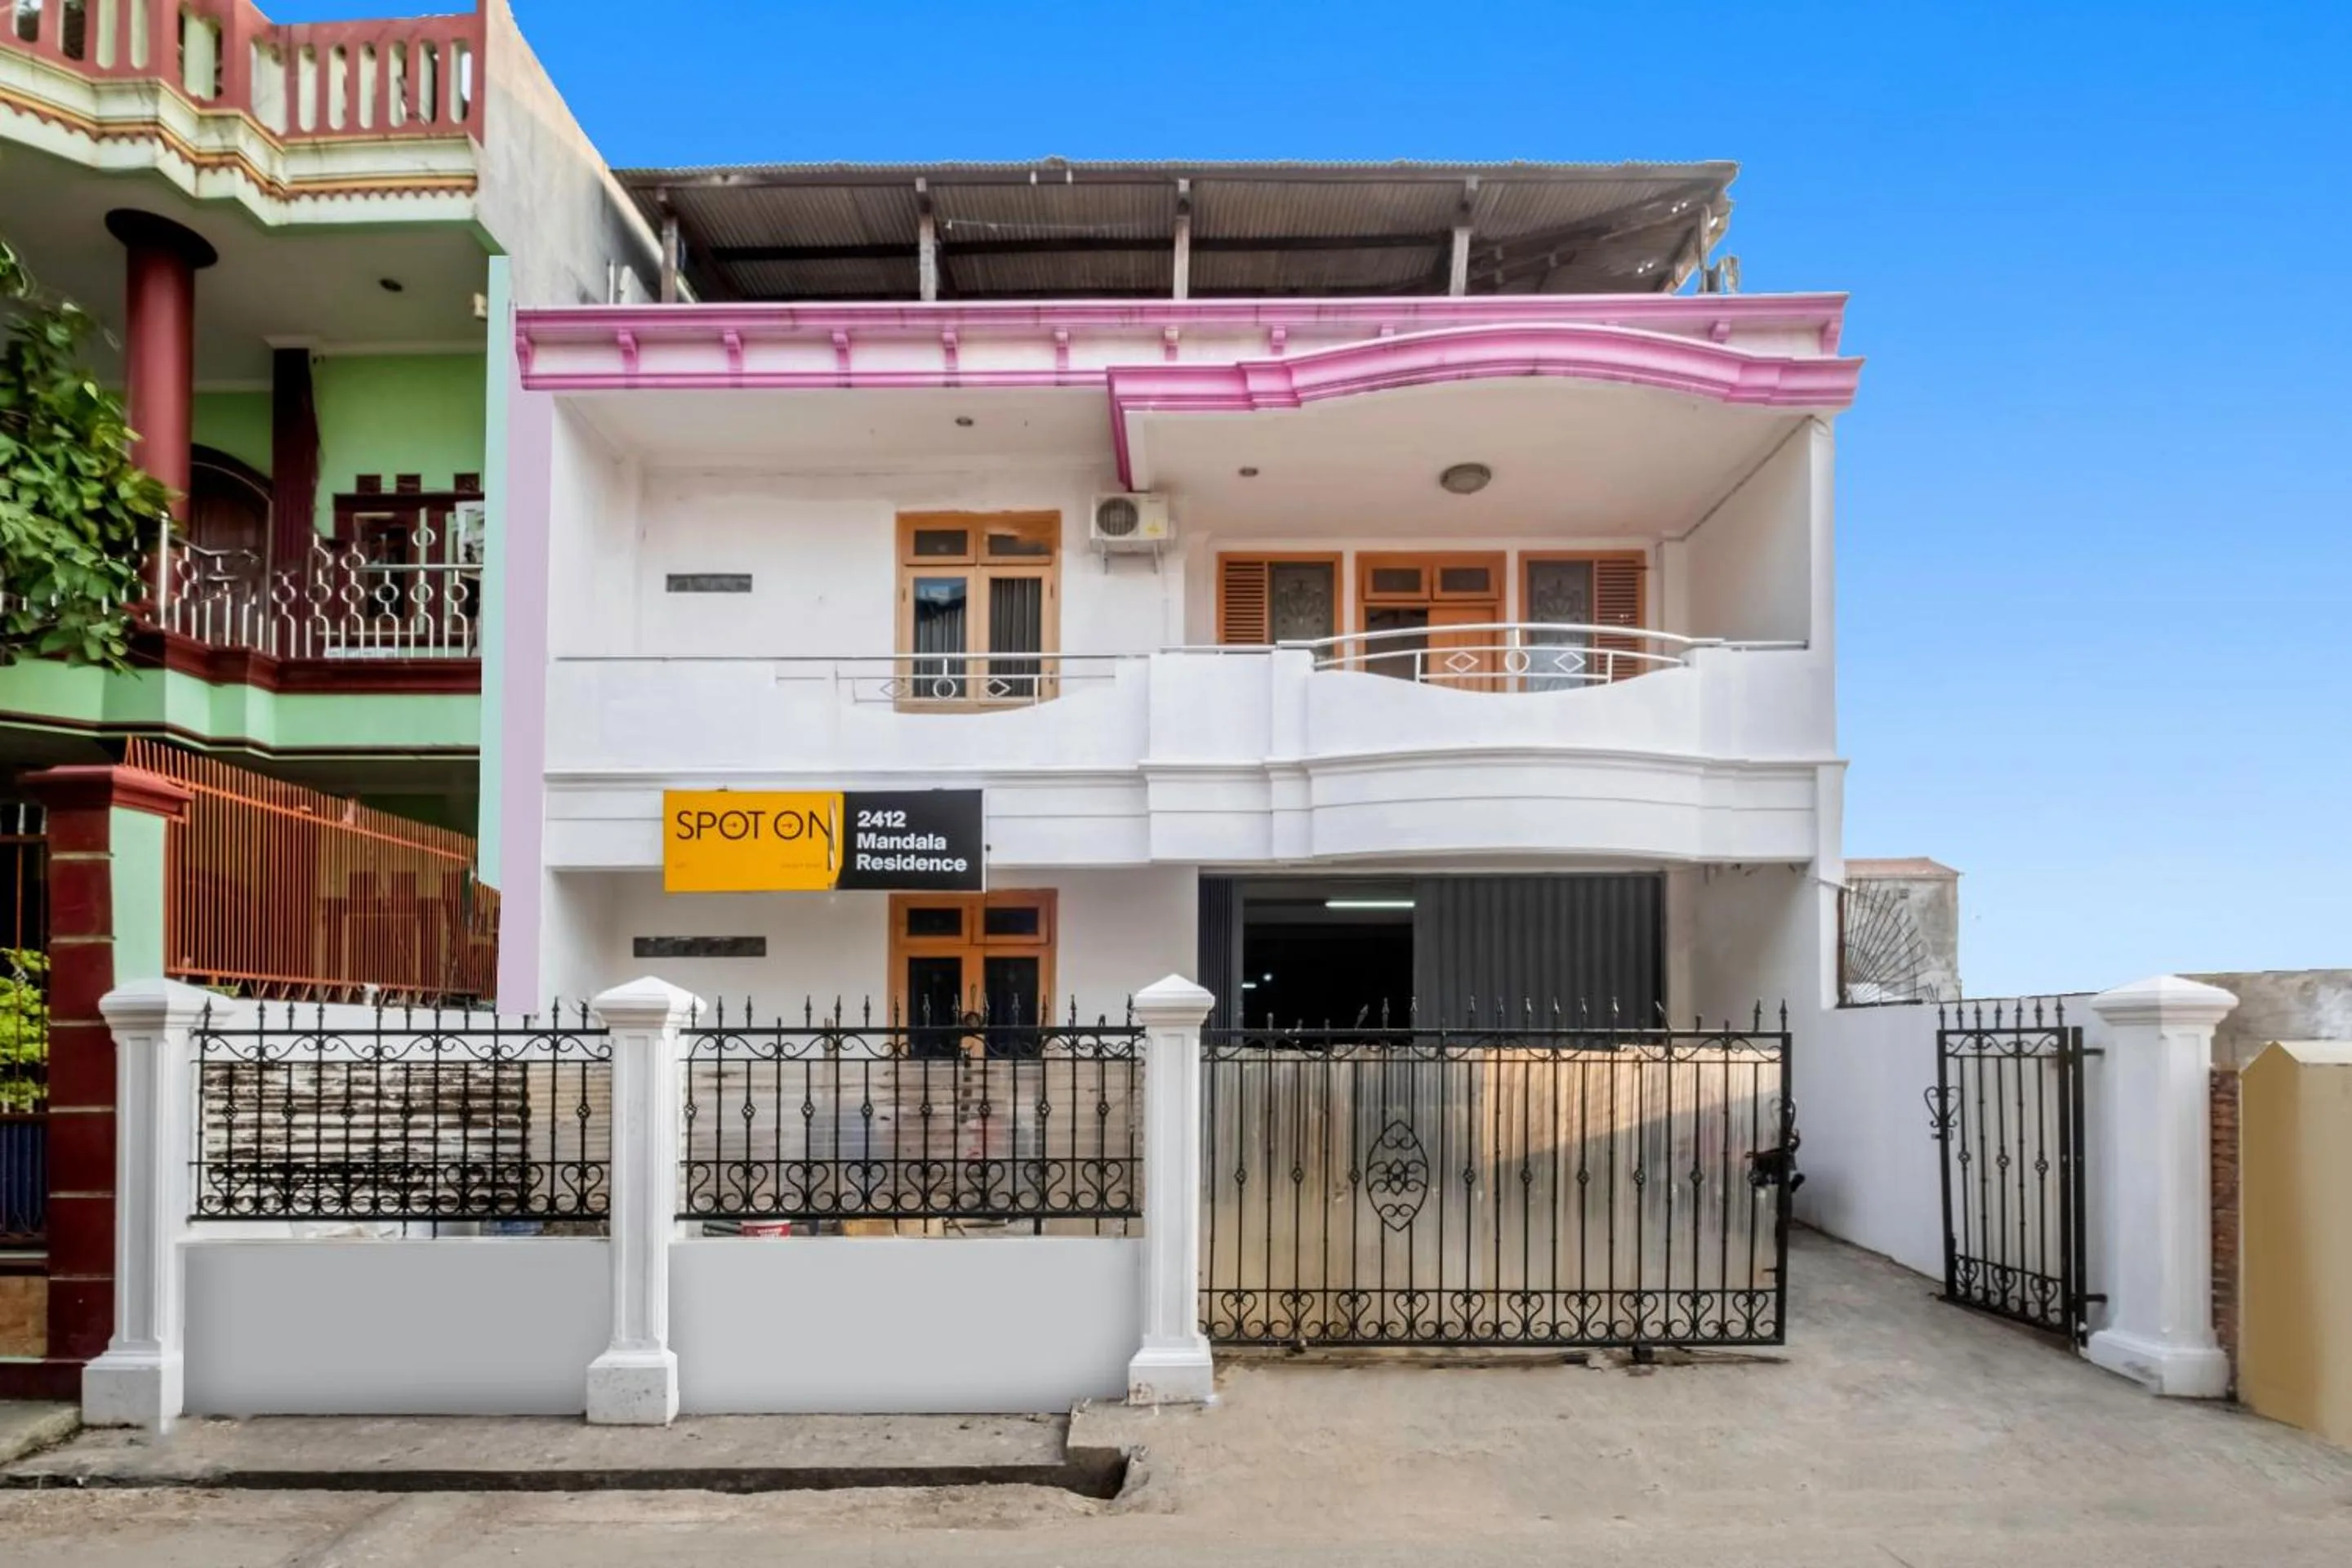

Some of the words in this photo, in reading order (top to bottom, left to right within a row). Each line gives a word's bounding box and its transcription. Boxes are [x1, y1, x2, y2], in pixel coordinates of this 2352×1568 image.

[676, 809, 766, 840] SPOT
[773, 809, 831, 840] ON
[857, 810, 906, 828] 2412
[857, 832, 947, 851] Mandala
[856, 853, 968, 872] Residence
